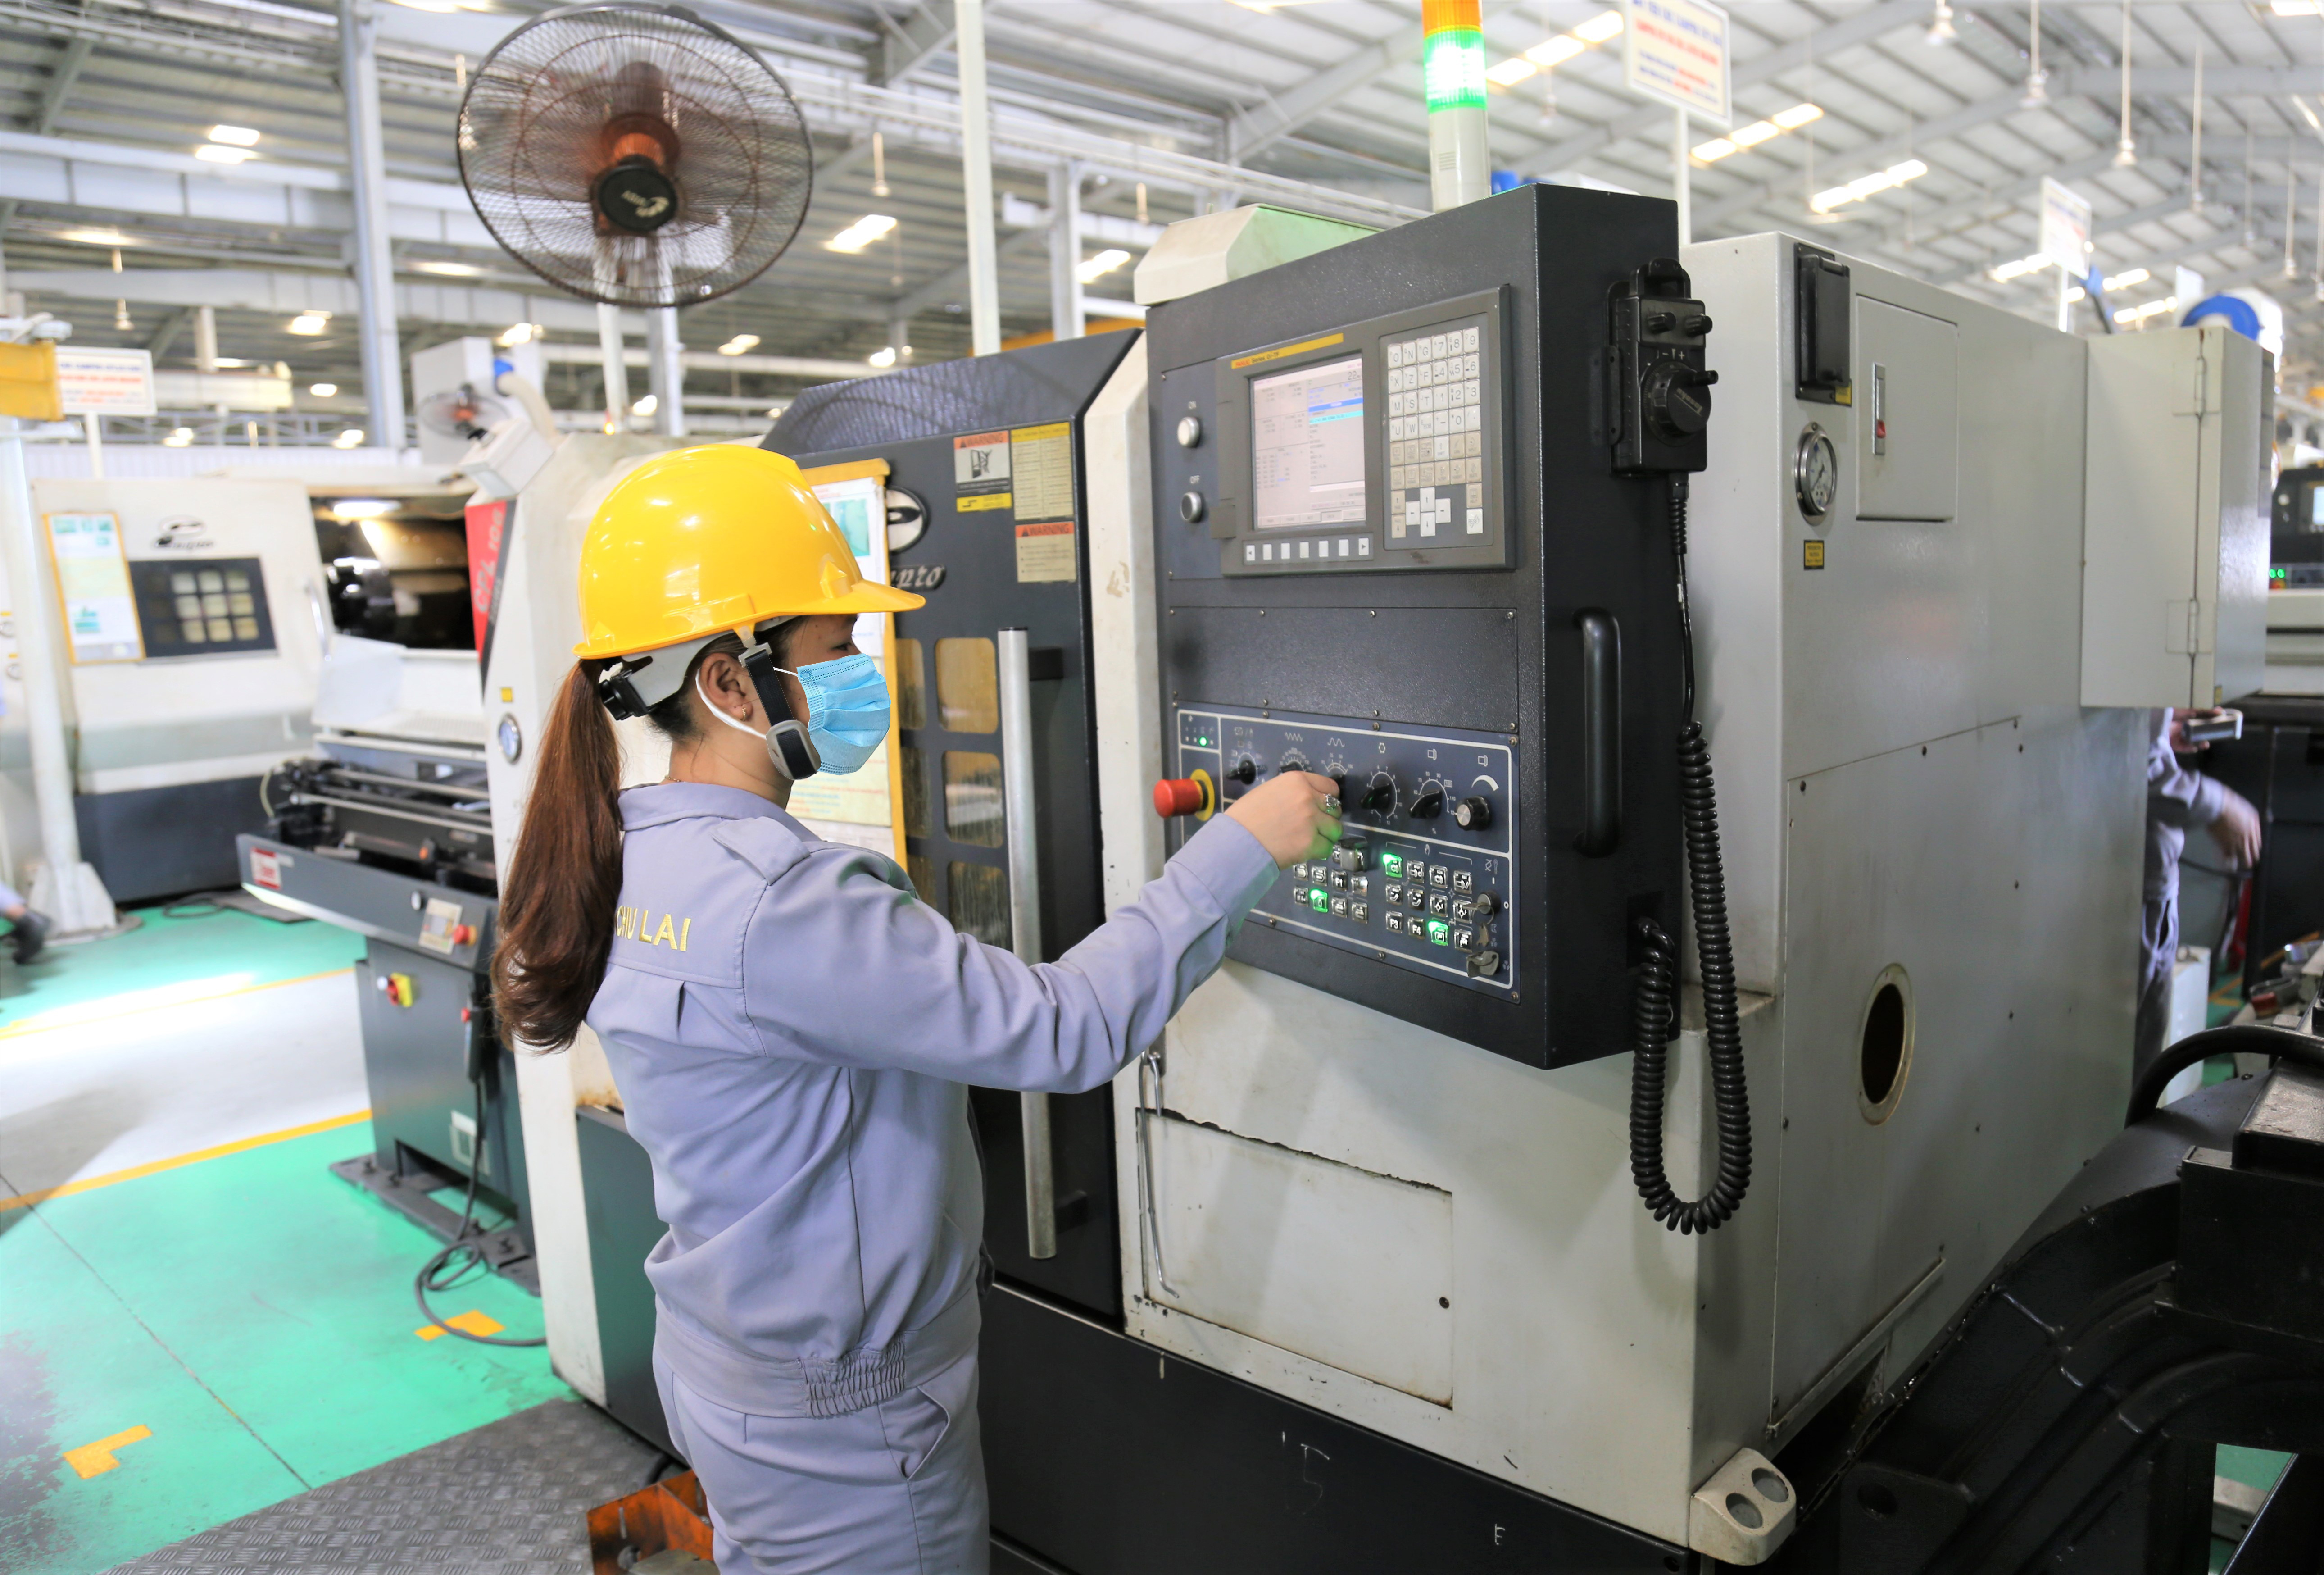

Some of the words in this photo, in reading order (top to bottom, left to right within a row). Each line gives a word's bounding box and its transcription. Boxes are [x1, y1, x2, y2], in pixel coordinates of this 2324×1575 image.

[1454, 339, 1460, 348] 8
[1470, 335, 1475, 345] 9
[1422, 347, 1429, 356] G
[1439, 342, 1444, 351] 7
[1408, 350, 1413, 360] N
[1454, 364, 1460, 374] 5
[1470, 361, 1476, 371] 6
[1424, 372, 1429, 381] F
[1439, 367, 1445, 376] 4
[1394, 378, 1399, 387] X
[1409, 374, 1414, 384] Z
[1456, 390, 1461, 400] 2
[1471, 387, 1477, 397] 3
[1424, 396, 1430, 406] T
[1441, 393, 1444, 402] 1
[1394, 402, 1400, 410] M
[1410, 399, 1415, 409] S
[1396, 426, 1400, 435] U
[1409, 424, 1416, 432] W
[967, 432, 1003, 446] WARNING
[1030, 523, 1069, 535] WARNING
[1335, 877, 1343, 887] F1
[616, 905, 638, 940] CHU
[639, 910, 691, 952] LAI
[1390, 918, 1398, 929] F3
[1412, 924, 1421, 935] F4
